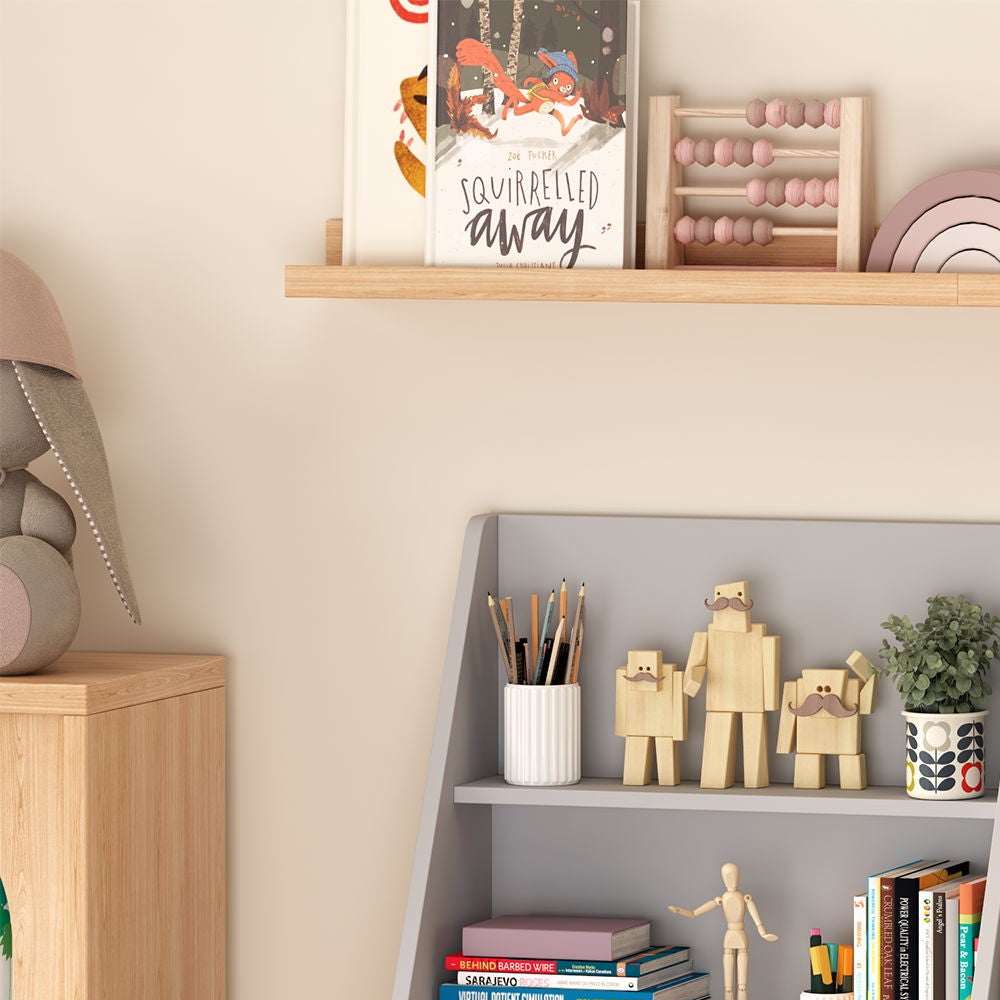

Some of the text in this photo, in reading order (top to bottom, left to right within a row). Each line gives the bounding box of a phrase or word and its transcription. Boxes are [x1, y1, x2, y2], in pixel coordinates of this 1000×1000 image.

[464, 206, 597, 269] away
[899, 897, 909, 919] POWER
[883, 895, 893, 990] CRUMBLED OAK LEAF
[898, 920, 909, 947] QUALITY
[459, 960, 555, 973] BEHIND BARBED WIRE
[899, 953, 909, 991] ELECTRICAL
[960, 926, 969, 990] Pear & Bacon
[465, 975, 550, 988] SARAJEVO ROSES
